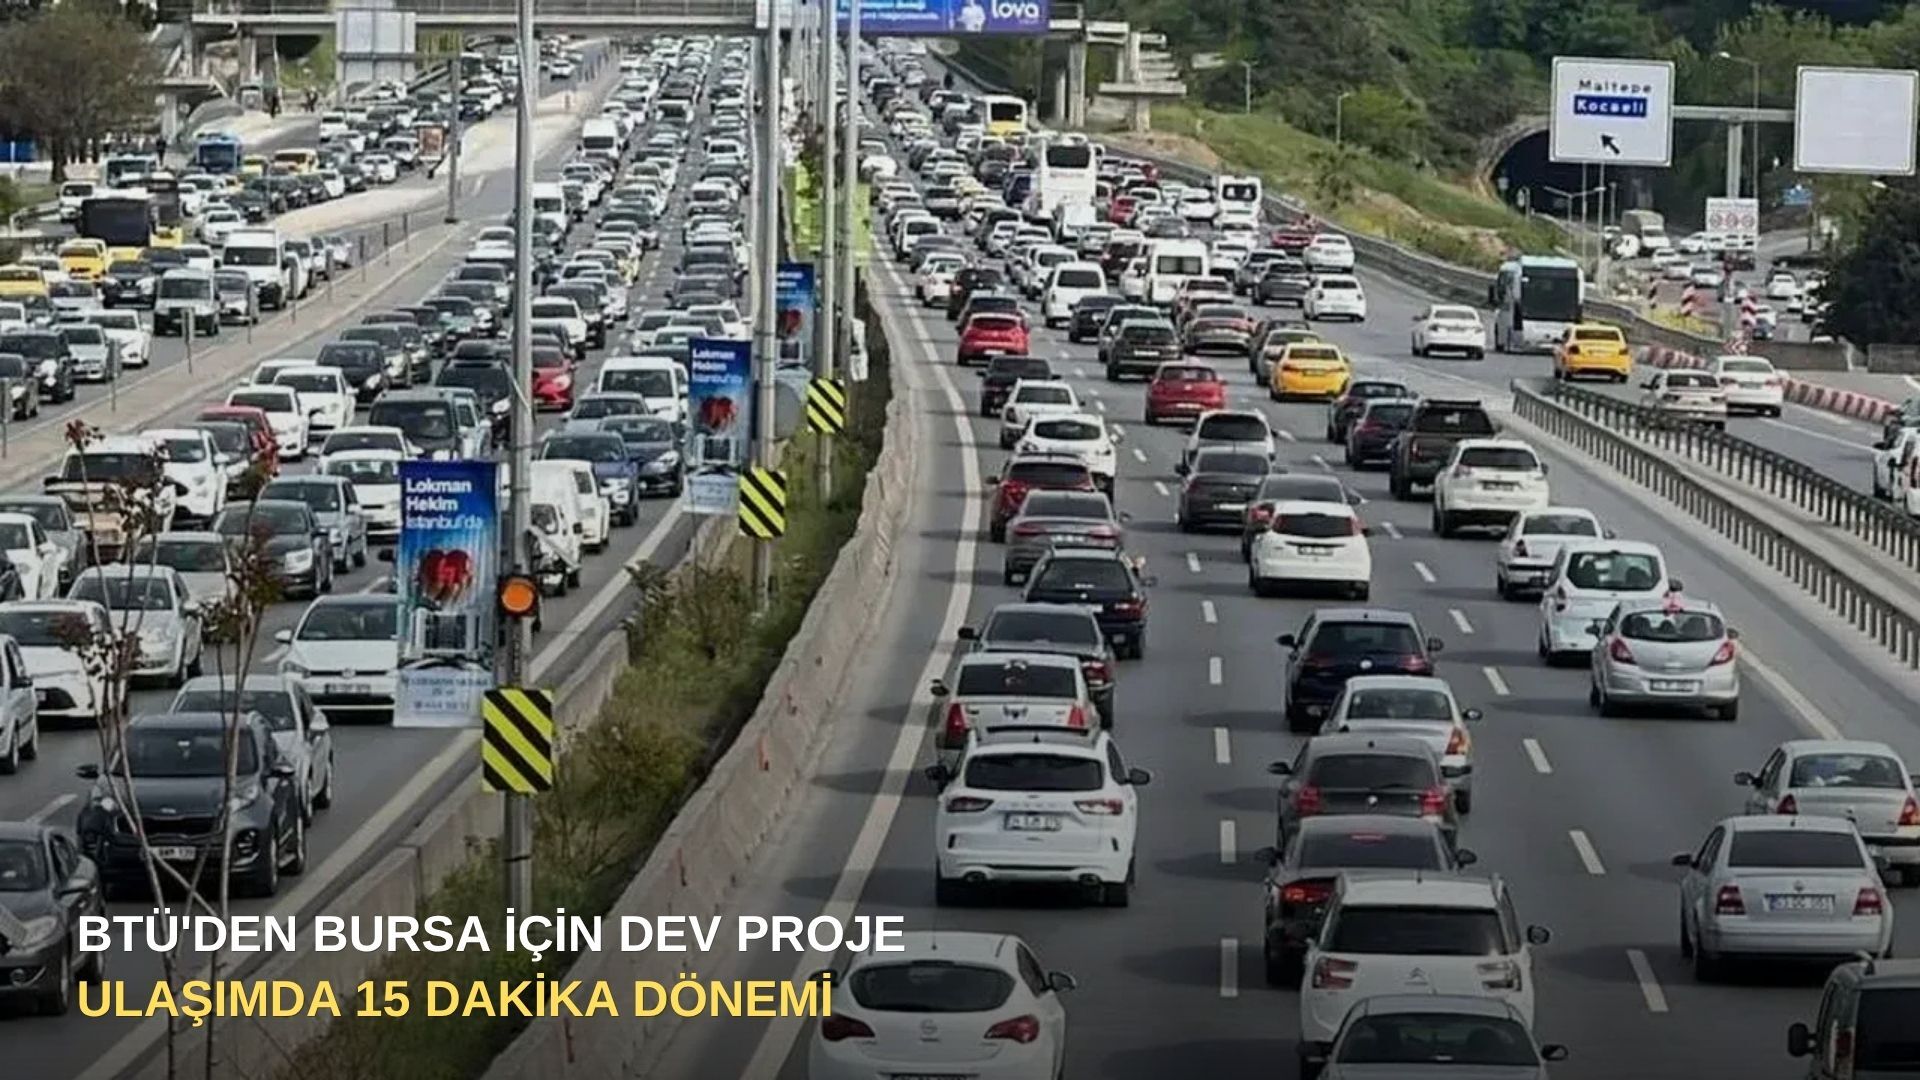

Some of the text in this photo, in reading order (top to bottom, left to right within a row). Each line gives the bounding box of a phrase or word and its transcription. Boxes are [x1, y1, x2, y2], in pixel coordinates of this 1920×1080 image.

[991, 0, 1039, 19] lova
[1579, 79, 1651, 94] Maltepe
[1577, 99, 1644, 114] Kocaeli
[406, 477, 472, 493] Lokman
[406, 495, 459, 511] Hekim
